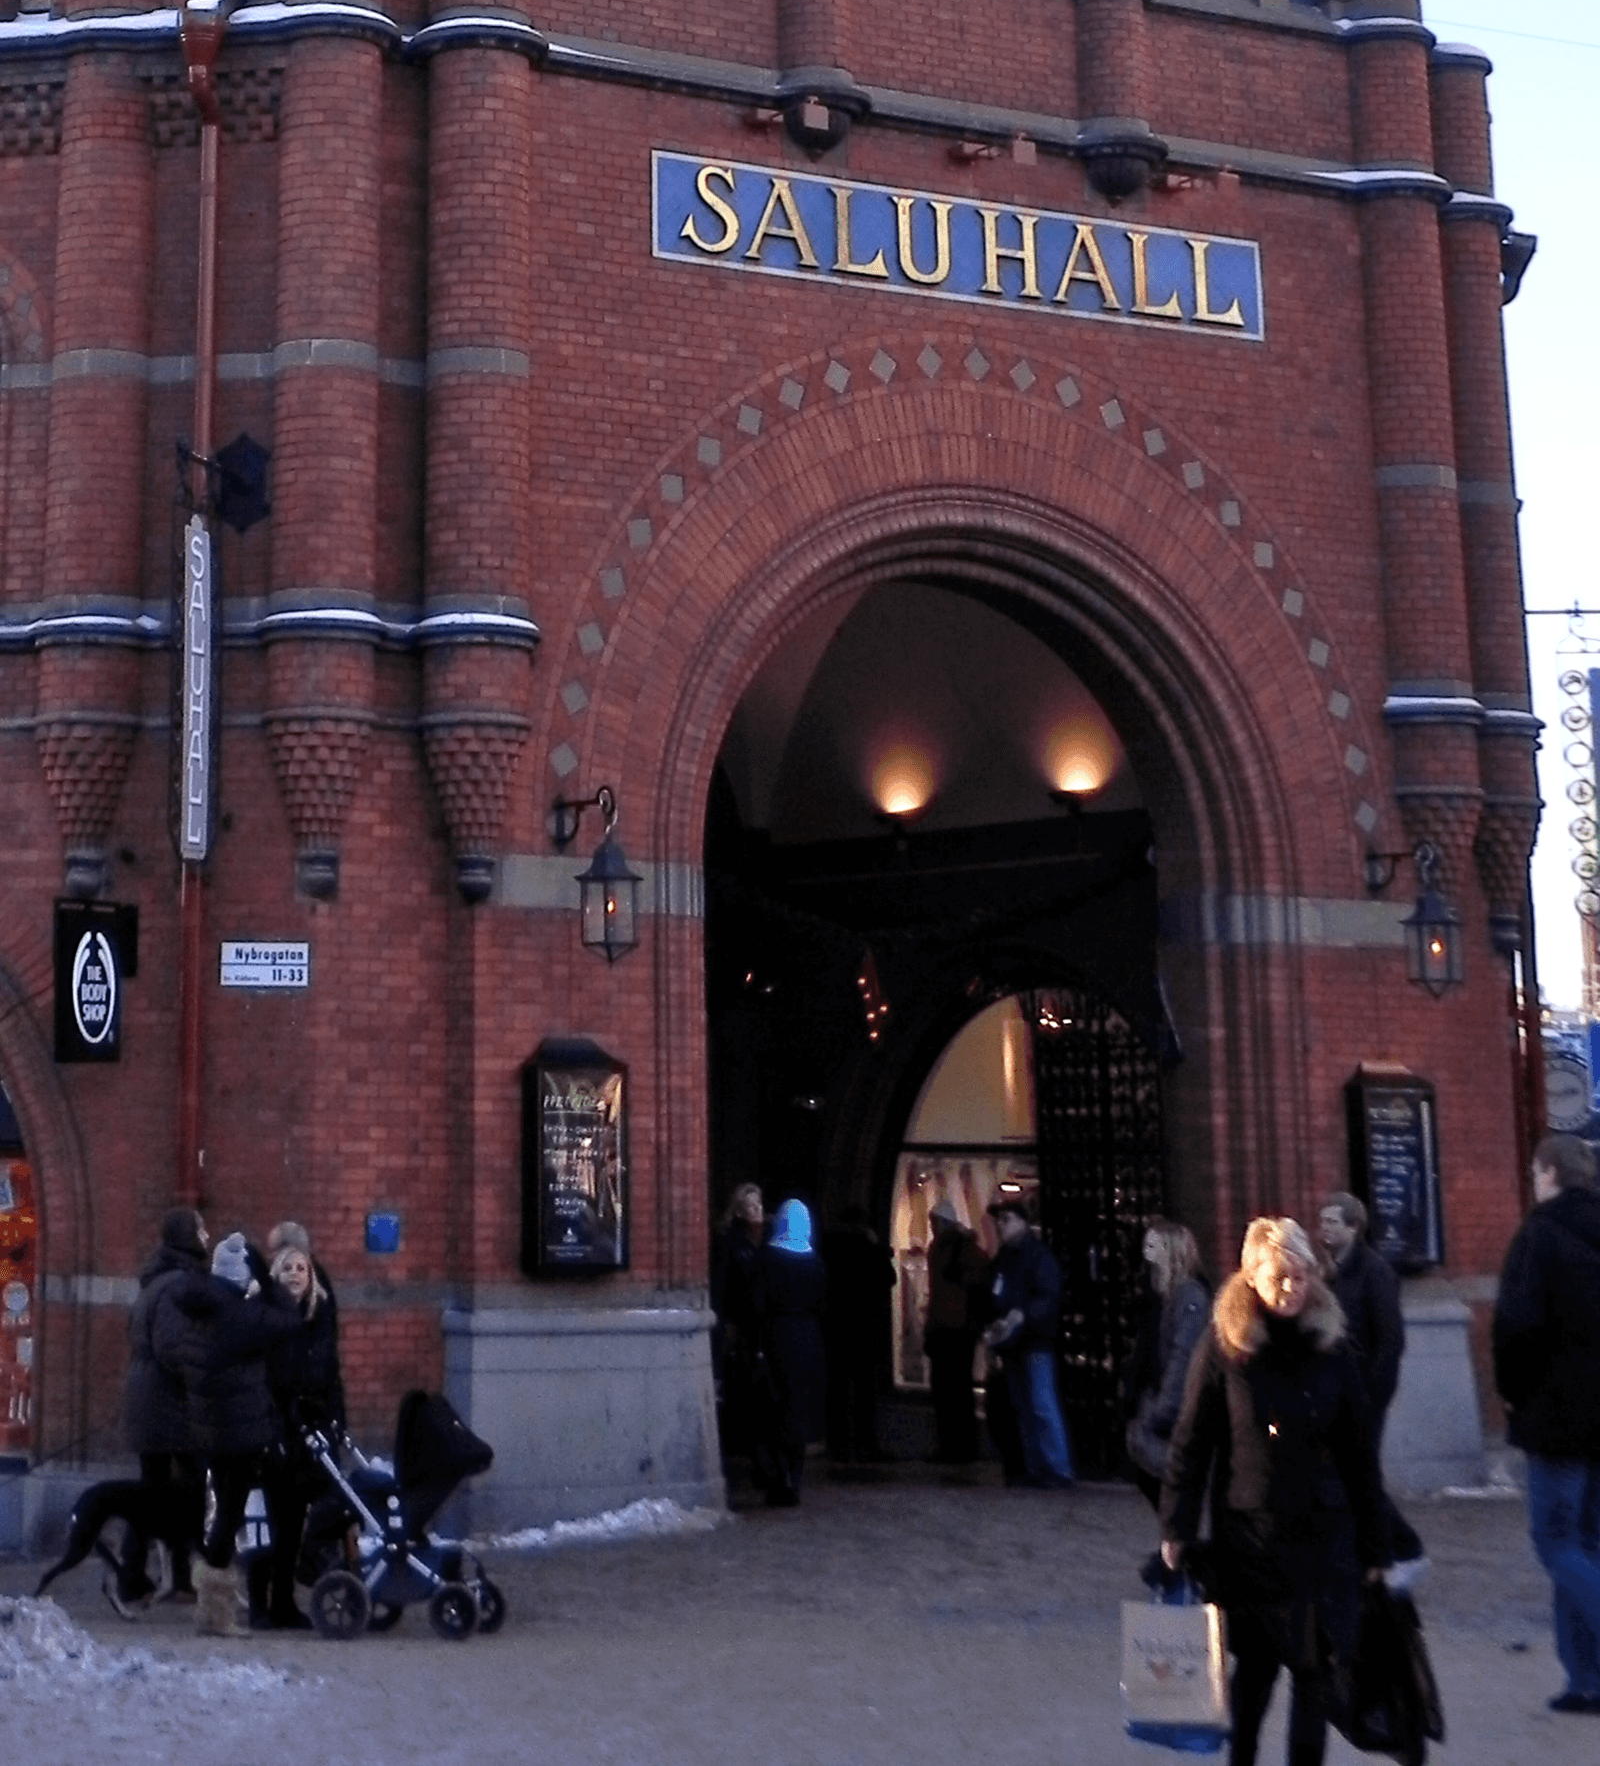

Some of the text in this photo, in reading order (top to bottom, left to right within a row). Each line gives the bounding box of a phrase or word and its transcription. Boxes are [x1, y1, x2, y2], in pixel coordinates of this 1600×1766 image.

[680, 165, 1245, 326] SALUHALL
[187, 536, 205, 843] SALUHALL
[235, 947, 304, 965] Nybrogatan
[86, 965, 102, 980] THE
[272, 968, 304, 982] 11-33
[81, 983, 107, 1002] BODY
[82, 1003, 107, 1022] SHOP
